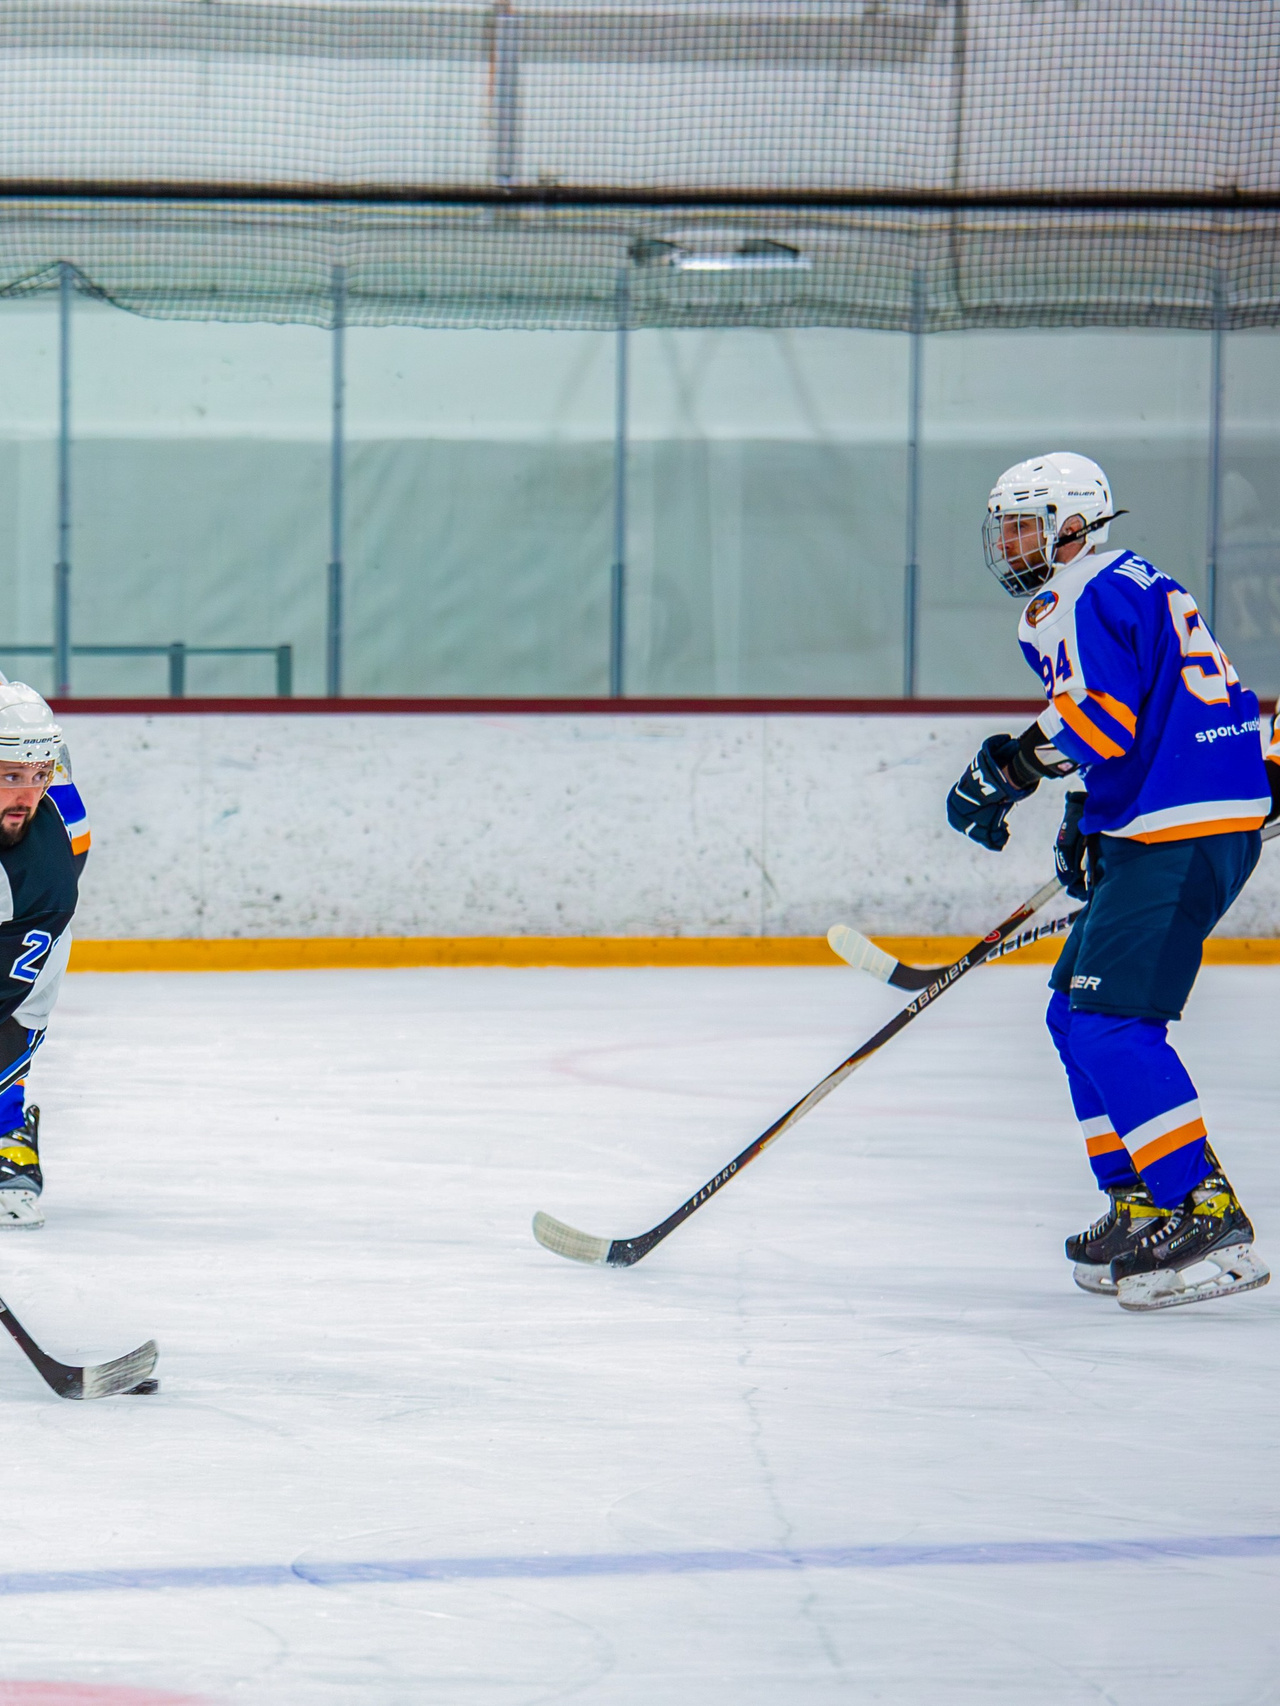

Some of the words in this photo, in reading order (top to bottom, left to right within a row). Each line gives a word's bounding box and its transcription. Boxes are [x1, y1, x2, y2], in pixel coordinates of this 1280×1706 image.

[1039, 638, 1074, 700] 94
[22, 737, 53, 745] BAUER
[9, 930, 56, 983] 2
[919, 955, 971, 1008] BAUER
[692, 1162, 738, 1207] FLYPRO
